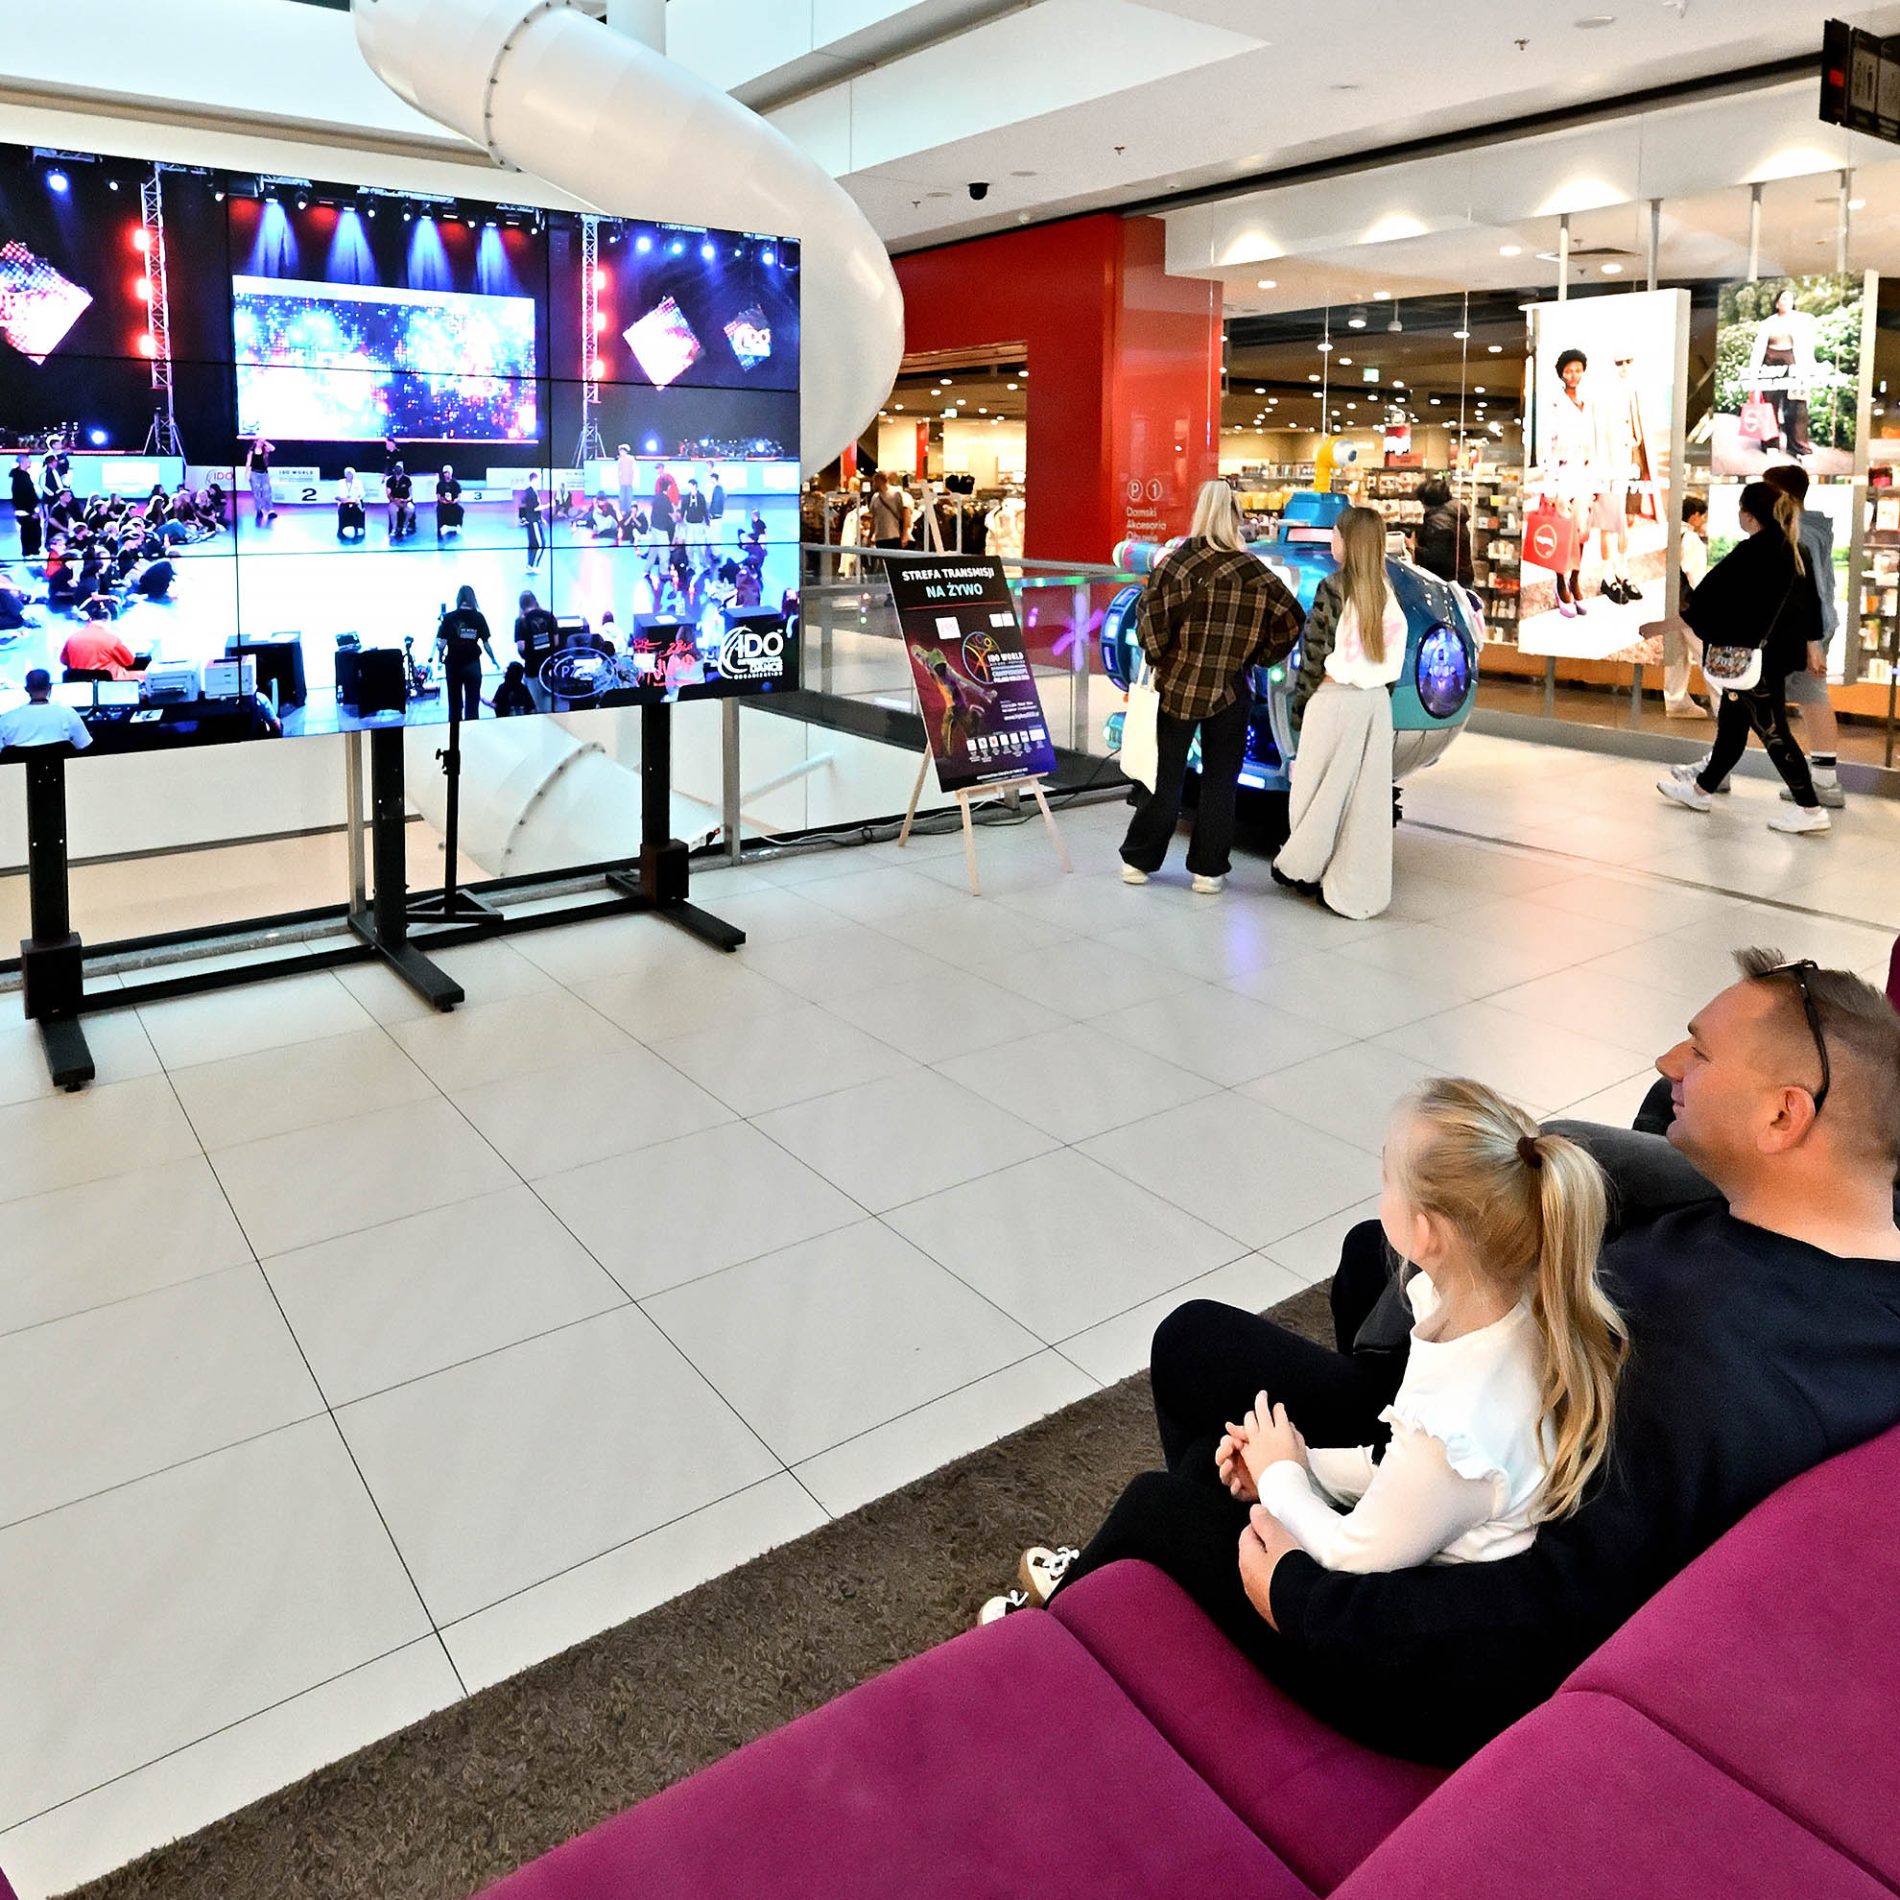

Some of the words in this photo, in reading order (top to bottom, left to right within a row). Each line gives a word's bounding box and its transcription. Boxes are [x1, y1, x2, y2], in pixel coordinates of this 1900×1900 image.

[302, 487, 318, 502] 2
[473, 491, 483, 501] 3
[902, 569, 941, 582] STREFA
[941, 566, 995, 580] TRANSMISJI
[925, 586, 946, 598] NA
[947, 581, 983, 597] ŻYWO
[738, 631, 784, 658] IDO
[1001, 651, 1024, 661] WORLD
